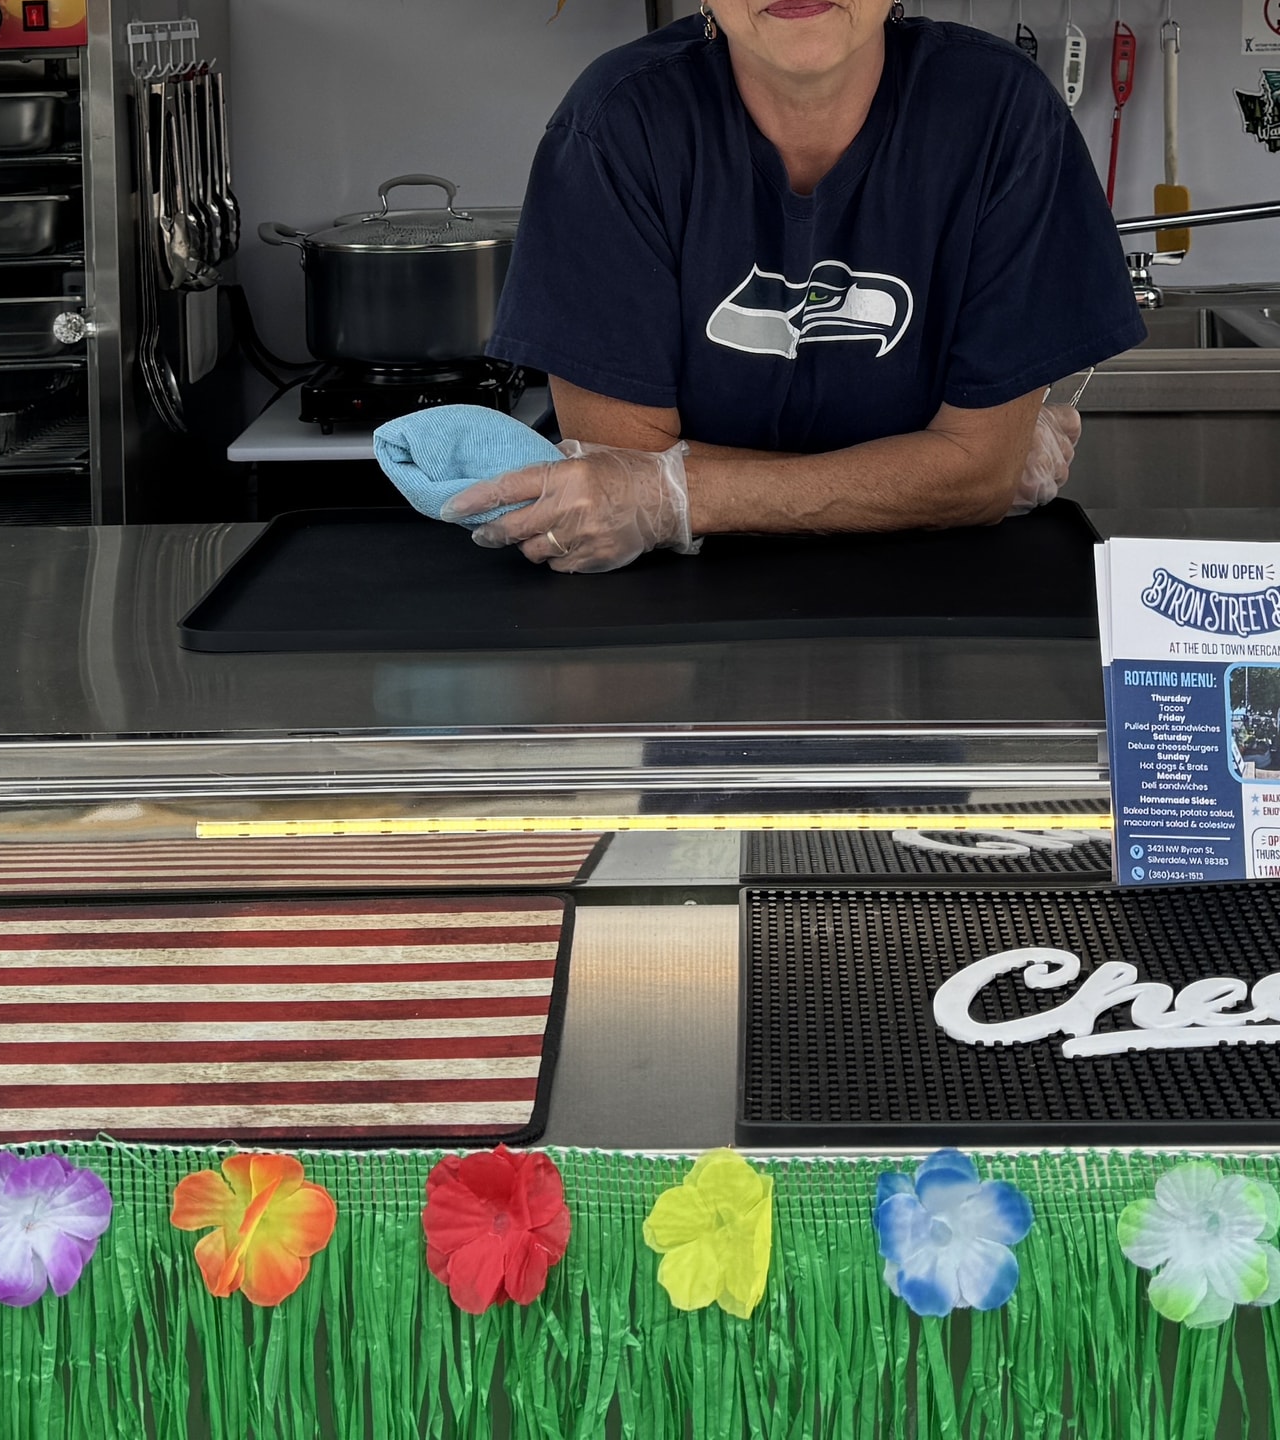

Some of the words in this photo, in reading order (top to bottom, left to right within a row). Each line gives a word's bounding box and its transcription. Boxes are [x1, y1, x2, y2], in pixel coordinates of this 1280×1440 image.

[1201, 563, 1228, 580] NOW
[1233, 564, 1264, 580] OPEN
[1143, 569, 1206, 626] BYRON
[1205, 592, 1269, 636] STREET
[1169, 642, 1180, 654] AT
[1183, 643, 1199, 654] THE
[1202, 643, 1218, 655] OLD
[1220, 644, 1245, 655] TOWN
[1124, 670, 1178, 687] ROTATING
[1181, 672, 1217, 688] MENU:
[1151, 694, 1192, 704] Thursday
[1160, 704, 1185, 712] Tacos
[1158, 714, 1186, 724] Friday
[1124, 722, 1150, 730] Pulled
[1151, 723, 1170, 732] pork
[1171, 724, 1220, 733] sandwiches
[1152, 732, 1193, 743] Saturday
[1128, 742, 1155, 750] Deluxe
[1157, 743, 1219, 753] cheeseburgers
[1157, 752, 1190, 763] Sunday
[1157, 772, 1192, 782] Monday
[1141, 781, 1157, 789] Deli
[1159, 782, 1208, 791] sandwiches
[1140, 796, 1190, 804] Homemade
[1191, 797, 1217, 805] Sides:
[1123, 807, 1149, 815] Baked
[1151, 807, 1179, 816] beans,
[1180, 808, 1208, 818] potato
[1210, 809, 1235, 818] salad,
[1123, 819, 1164, 827] macaroni
[1166, 820, 1189, 828] salad
[1190, 820, 1197, 828] &
[1199, 821, 1236, 829] coleslaw
[1147, 856, 1189, 865] Silverdale,
[1189, 857, 1202, 865] WA
[1204, 857, 1229, 866] 98383
